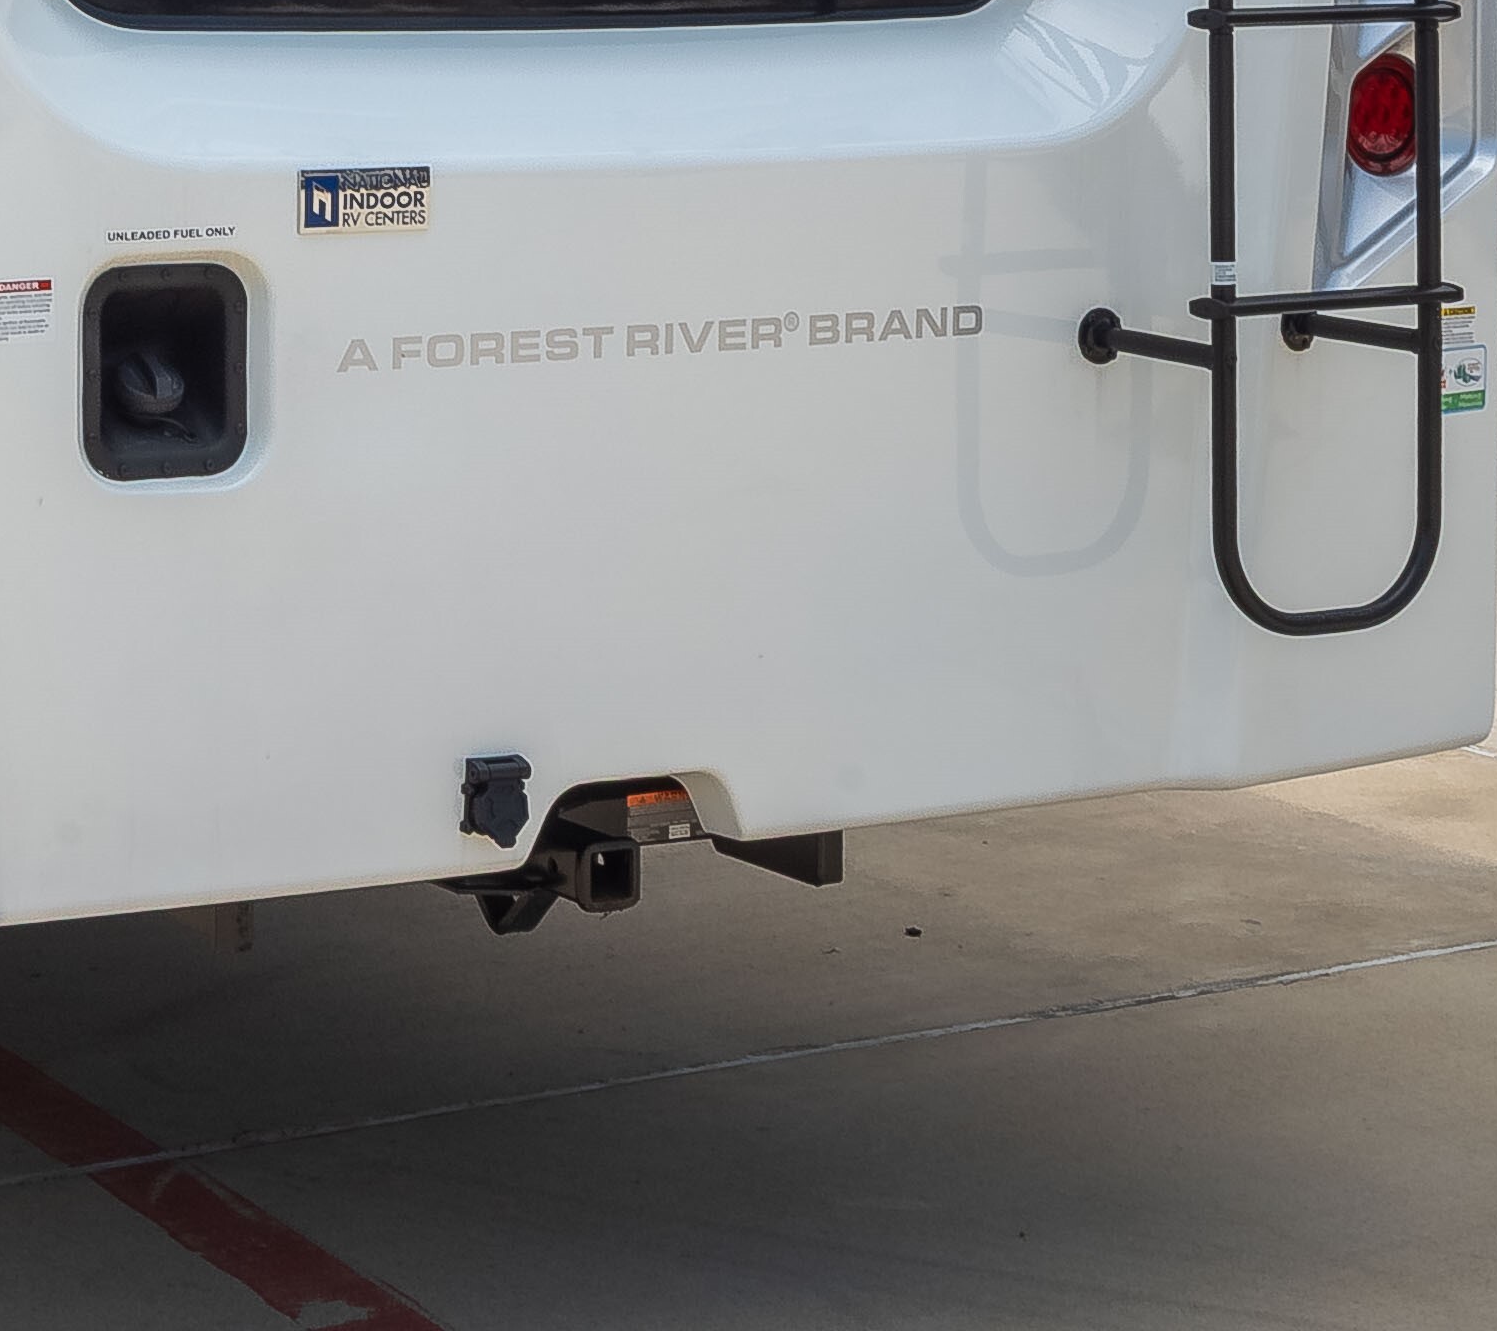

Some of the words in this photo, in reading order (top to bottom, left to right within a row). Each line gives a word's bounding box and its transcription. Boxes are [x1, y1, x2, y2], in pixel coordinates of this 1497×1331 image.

[342, 191, 426, 210] INDOOR
[342, 212, 361, 227] RV
[365, 210, 426, 227] CENTERS
[107, 230, 171, 242] UNLEADED
[173, 228, 203, 239] FUEL
[205, 226, 236, 236] ONLY
[336, 339, 379, 373] A
[391, 326, 614, 370] FOREST
[808, 305, 983, 346] BRAND
